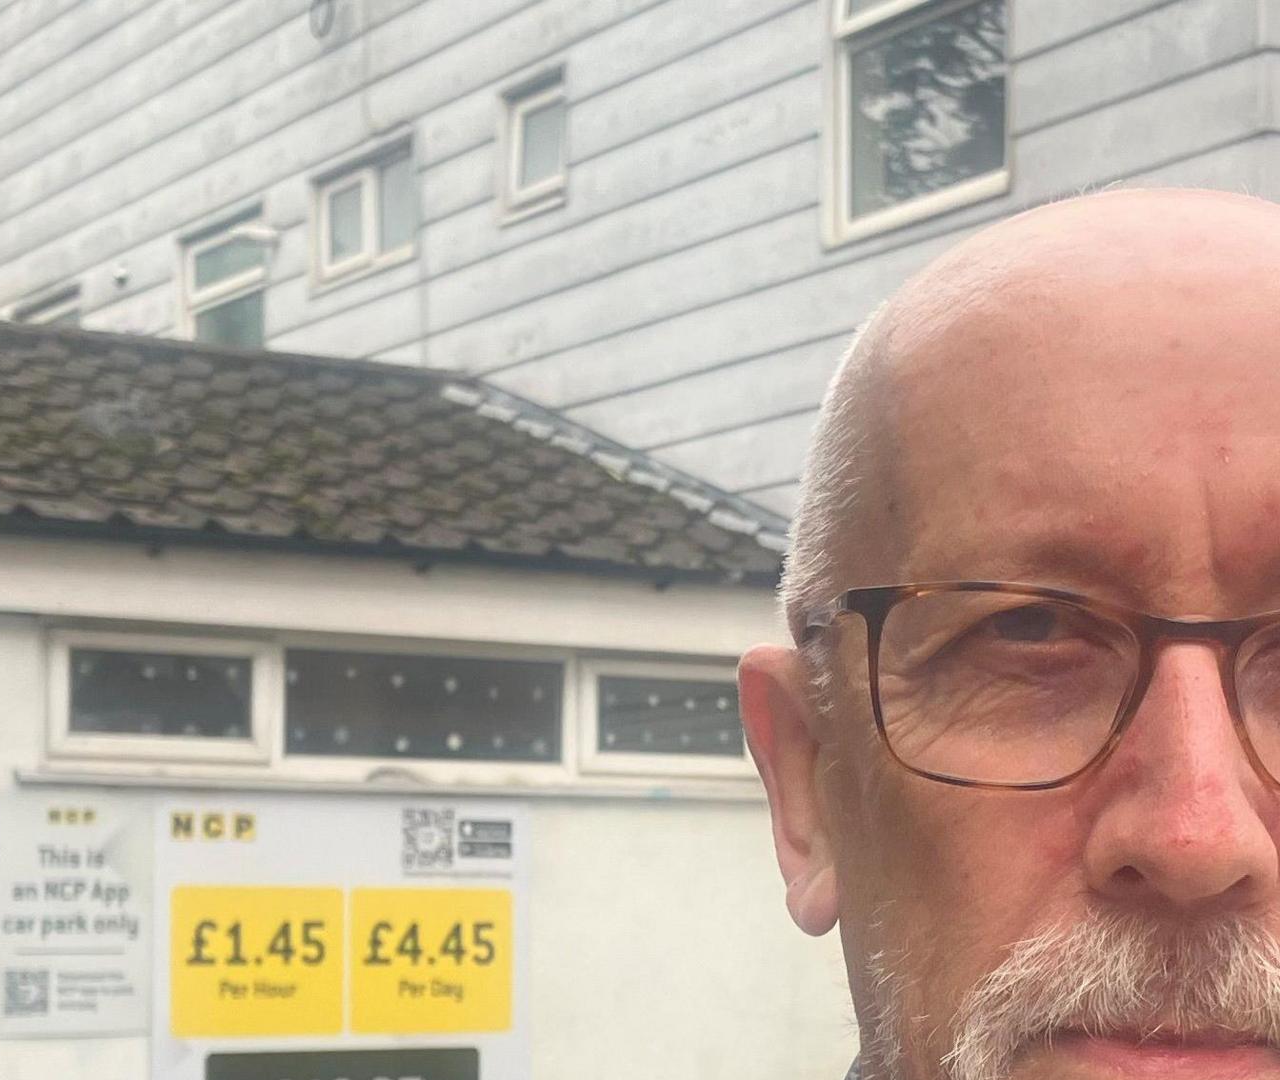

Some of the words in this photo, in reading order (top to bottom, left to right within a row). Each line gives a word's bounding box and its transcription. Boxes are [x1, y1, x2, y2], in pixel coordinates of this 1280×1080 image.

[171, 813, 256, 839] NCP
[38, 845, 80, 867] This
[86, 846, 104, 867] is
[13, 884, 37, 899] an
[45, 881, 86, 900] NCP
[91, 881, 130, 906] App
[2, 919, 34, 935] car
[41, 917, 87, 940] park
[93, 917, 138, 940] only
[186, 921, 327, 966] £1.45
[363, 922, 496, 966] £4.45
[220, 981, 249, 997] Per
[398, 980, 428, 996] Per
